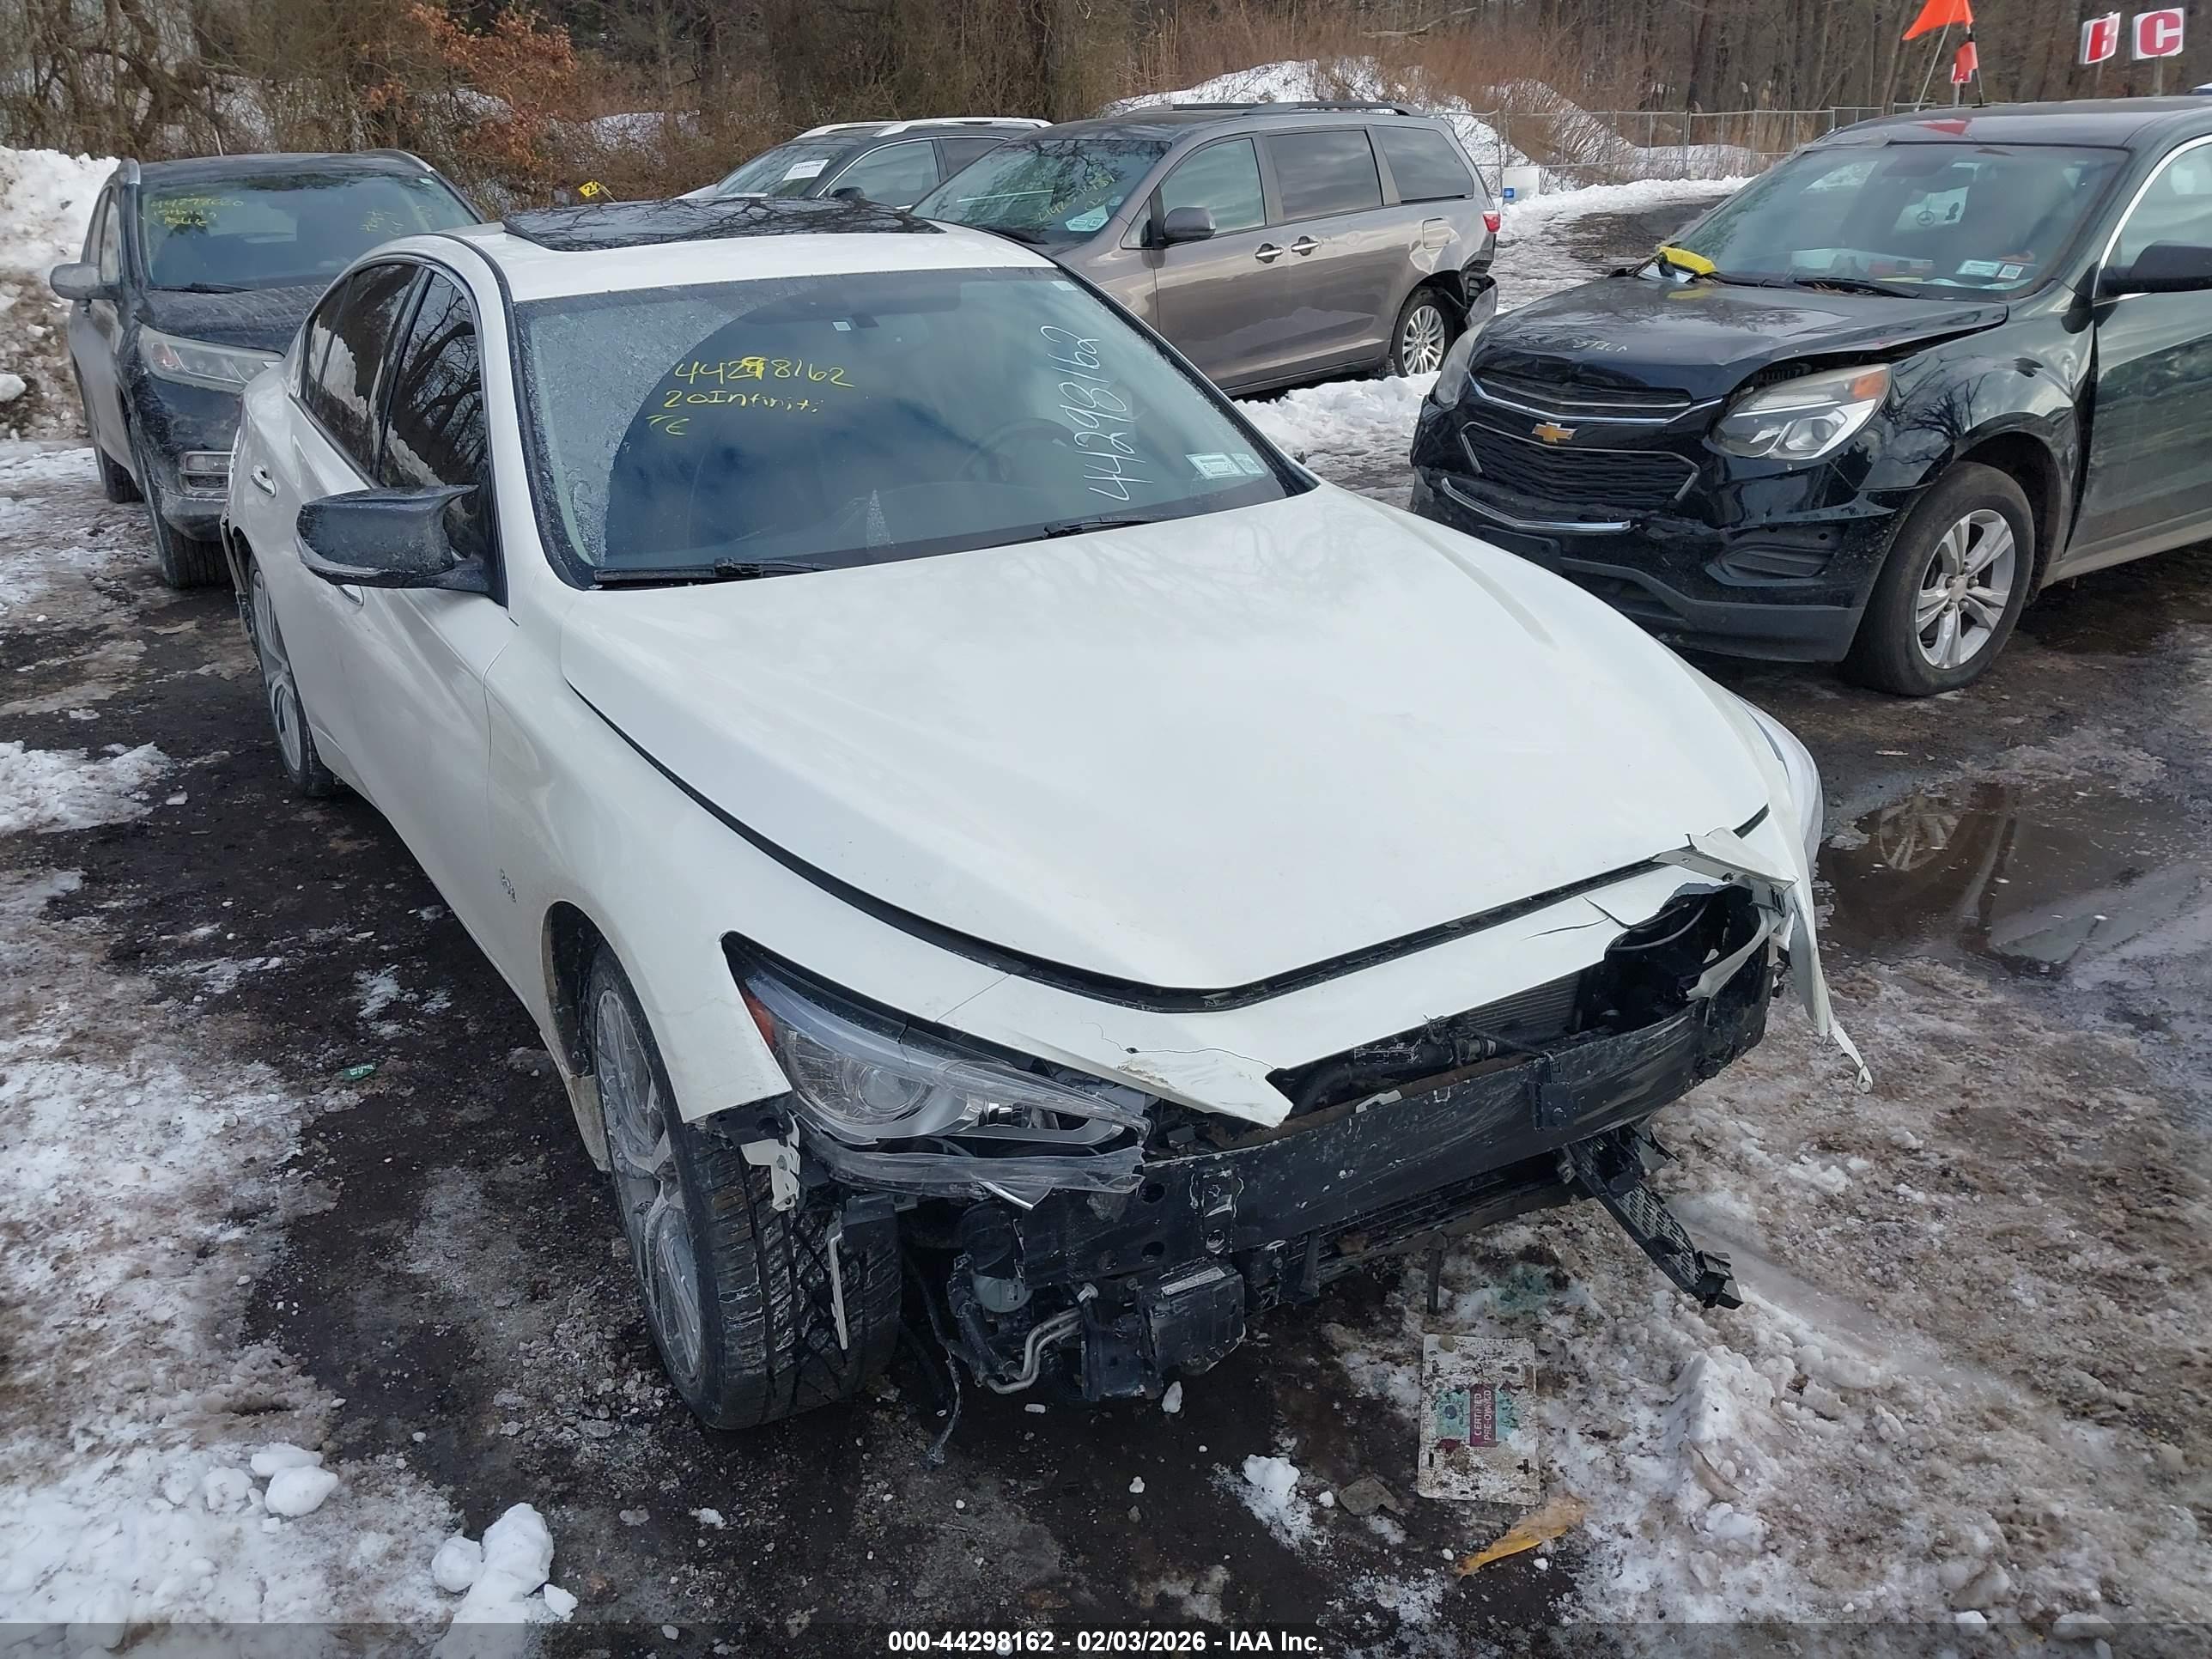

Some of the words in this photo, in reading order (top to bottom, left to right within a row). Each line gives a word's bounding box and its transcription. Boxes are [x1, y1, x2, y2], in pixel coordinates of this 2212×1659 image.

[2087, 17, 2118, 63] B
[2140, 11, 2181, 56] C
[1040, 325, 1155, 502] 44298162
[1474, 1393, 1482, 1436] CERTIFIED
[1484, 1389, 1492, 1441] PRE-OWNED
